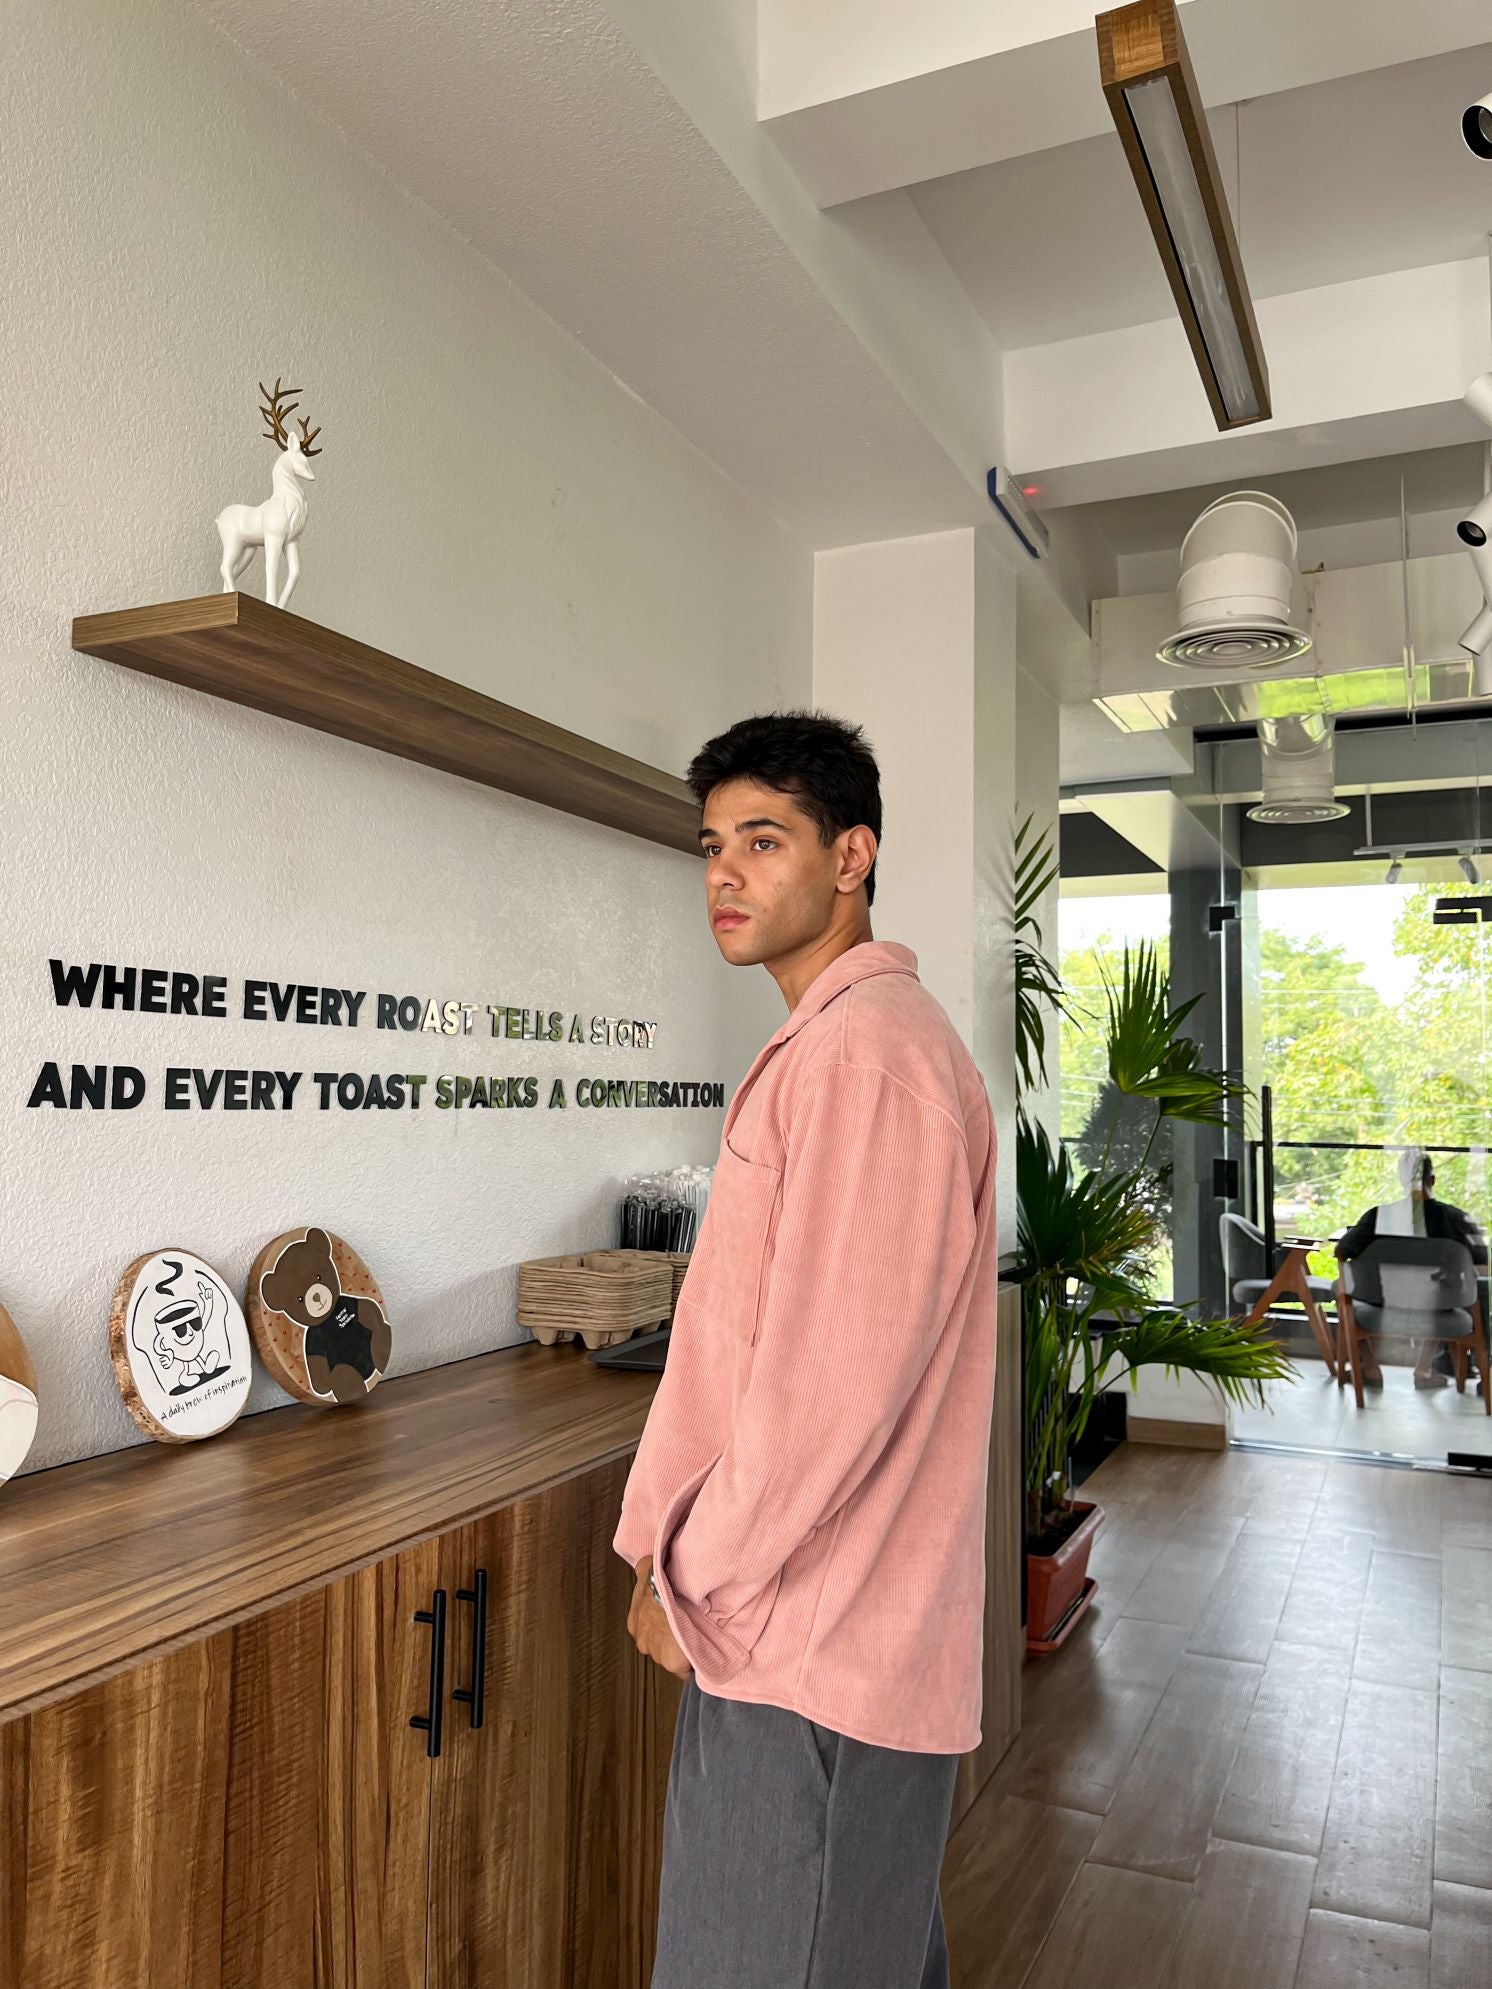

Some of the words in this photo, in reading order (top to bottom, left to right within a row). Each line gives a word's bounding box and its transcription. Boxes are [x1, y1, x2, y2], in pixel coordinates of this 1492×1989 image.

[49, 958, 227, 1018] WHERE
[243, 979, 367, 1027] EVERY
[377, 993, 479, 1036] ROAST
[487, 1004, 563, 1042] TELLS
[568, 1013, 585, 1044] A
[591, 1015, 657, 1049] STORY
[26, 1062, 146, 1110] AND
[164, 1067, 303, 1110] EVERY
[313, 1072, 427, 1110] TOAST
[435, 1074, 539, 1110] SPARKS
[549, 1078, 566, 1110] A
[576, 1077, 725, 1109] CONVERSATION
[160, 1412, 168, 1421] A
[168, 1403, 185, 1418] daily
[204, 1387, 212, 1400] of
[212, 1375, 248, 1395] inspiration
